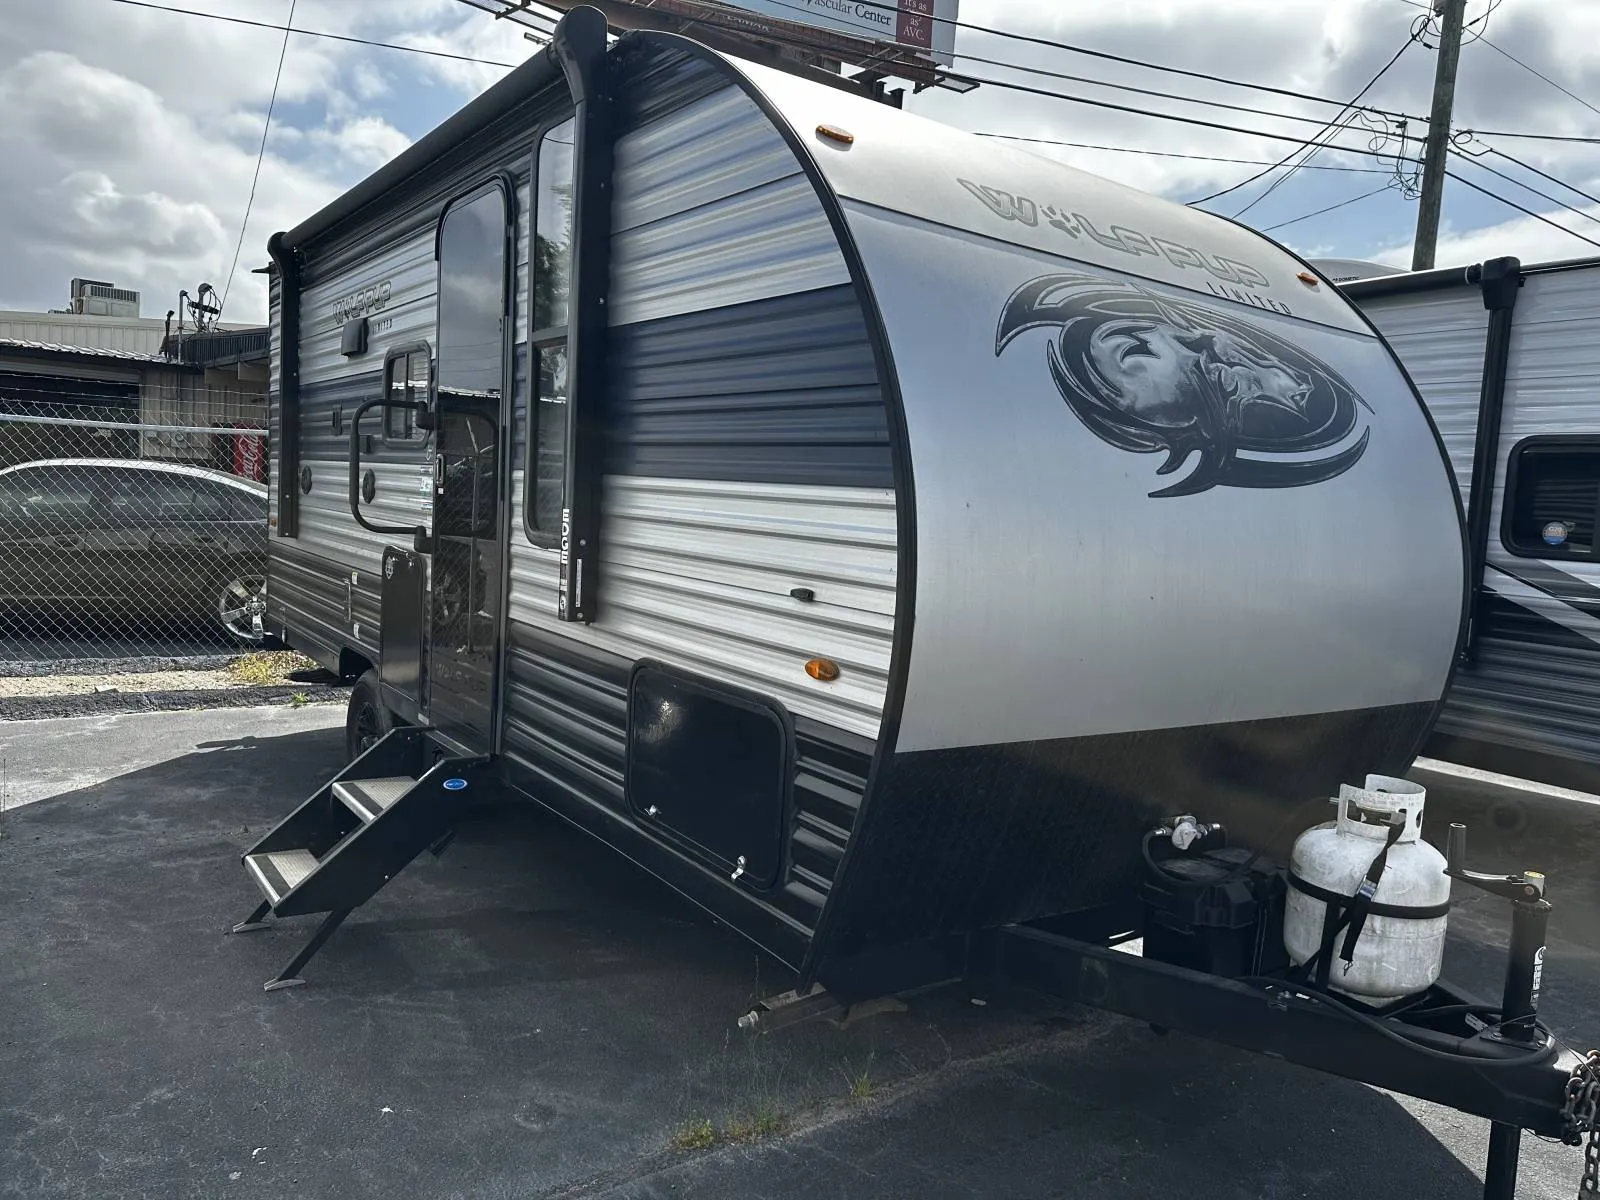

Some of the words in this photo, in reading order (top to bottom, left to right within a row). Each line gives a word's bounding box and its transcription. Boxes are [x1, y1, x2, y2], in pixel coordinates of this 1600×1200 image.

[918, 2, 927, 11] as
[855, 4, 892, 26] Center
[910, 18, 919, 26] as
[903, 25, 925, 40] AVC.
[1206, 281, 1292, 315] LIMITED
